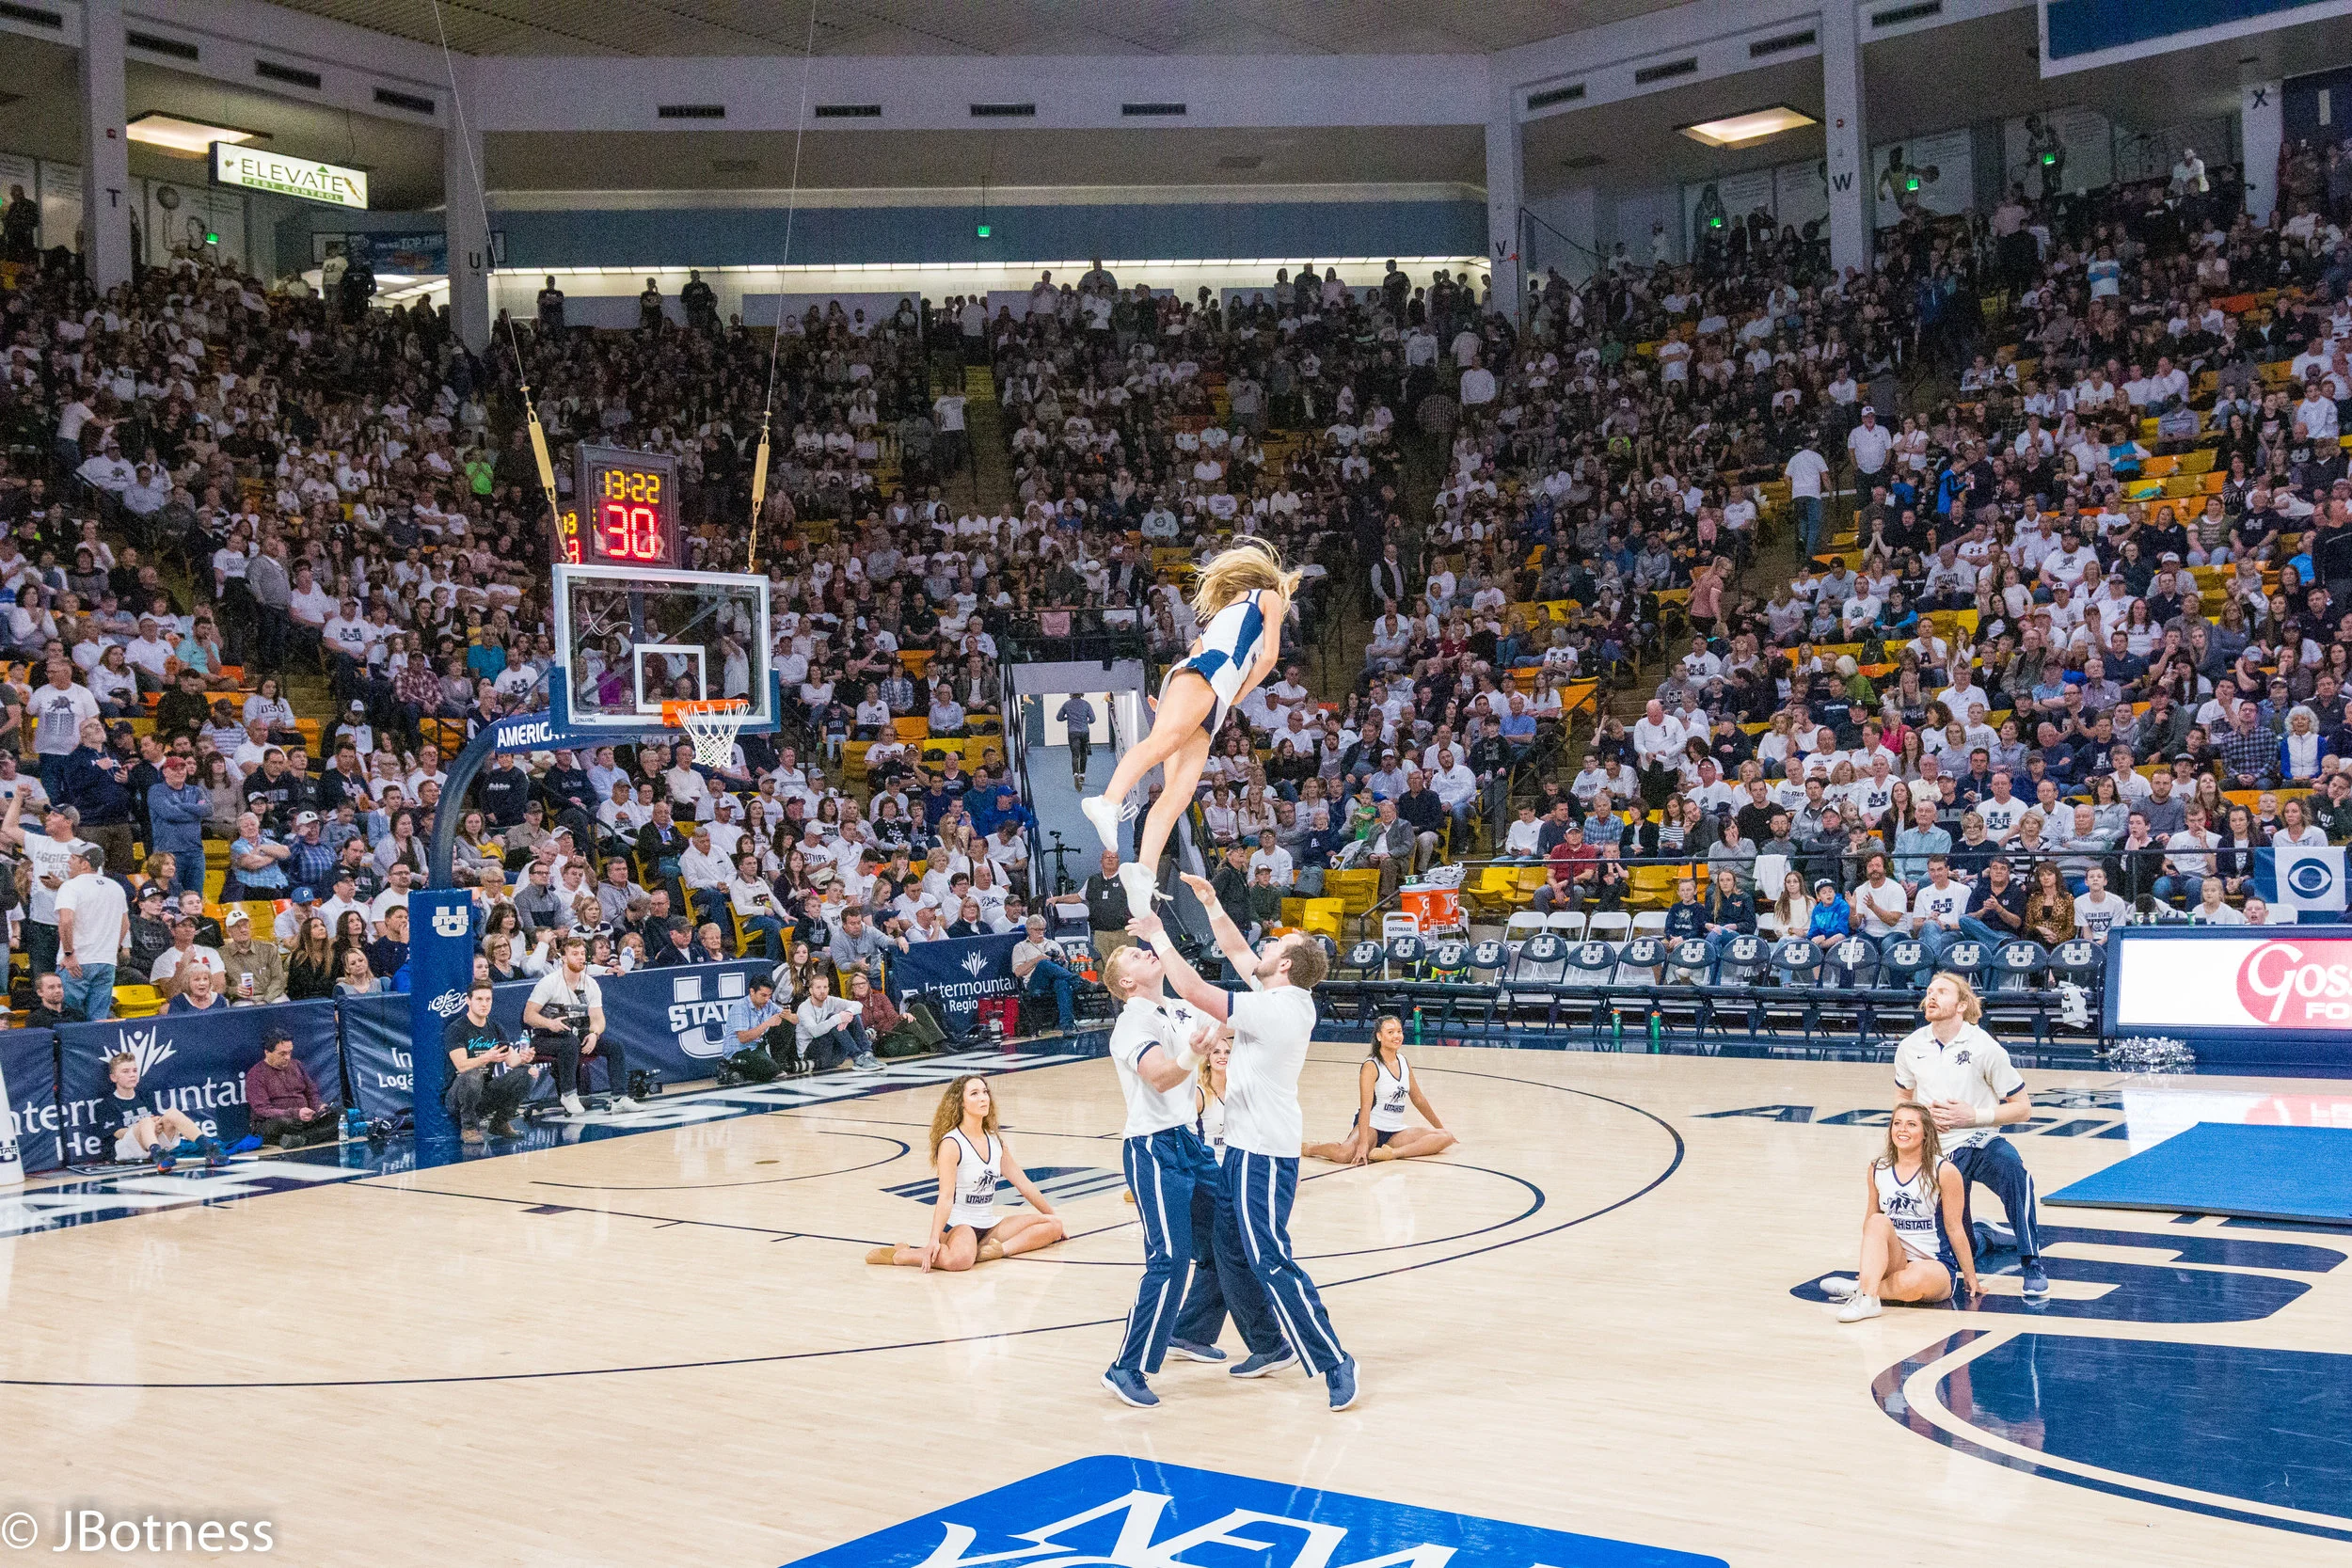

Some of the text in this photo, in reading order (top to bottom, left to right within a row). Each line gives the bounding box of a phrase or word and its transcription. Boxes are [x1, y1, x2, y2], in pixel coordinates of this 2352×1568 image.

[2252, 89, 2268, 108] X
[242, 158, 344, 193] ELEVATE
[1832, 172, 1853, 193] W
[106, 188, 121, 208] T
[244, 177, 342, 201] PEST CONTROL
[604, 470, 660, 504] 13:22
[607, 504, 657, 559] 30
[261, 704, 285, 714] USU
[803, 852, 827, 863] STRIPE
[668, 1001, 735, 1033] STAT
[2304, 1002, 2352, 1020] FO
[377, 1071, 414, 1089] Loga
[1905, 1219, 1933, 1230] STATE
